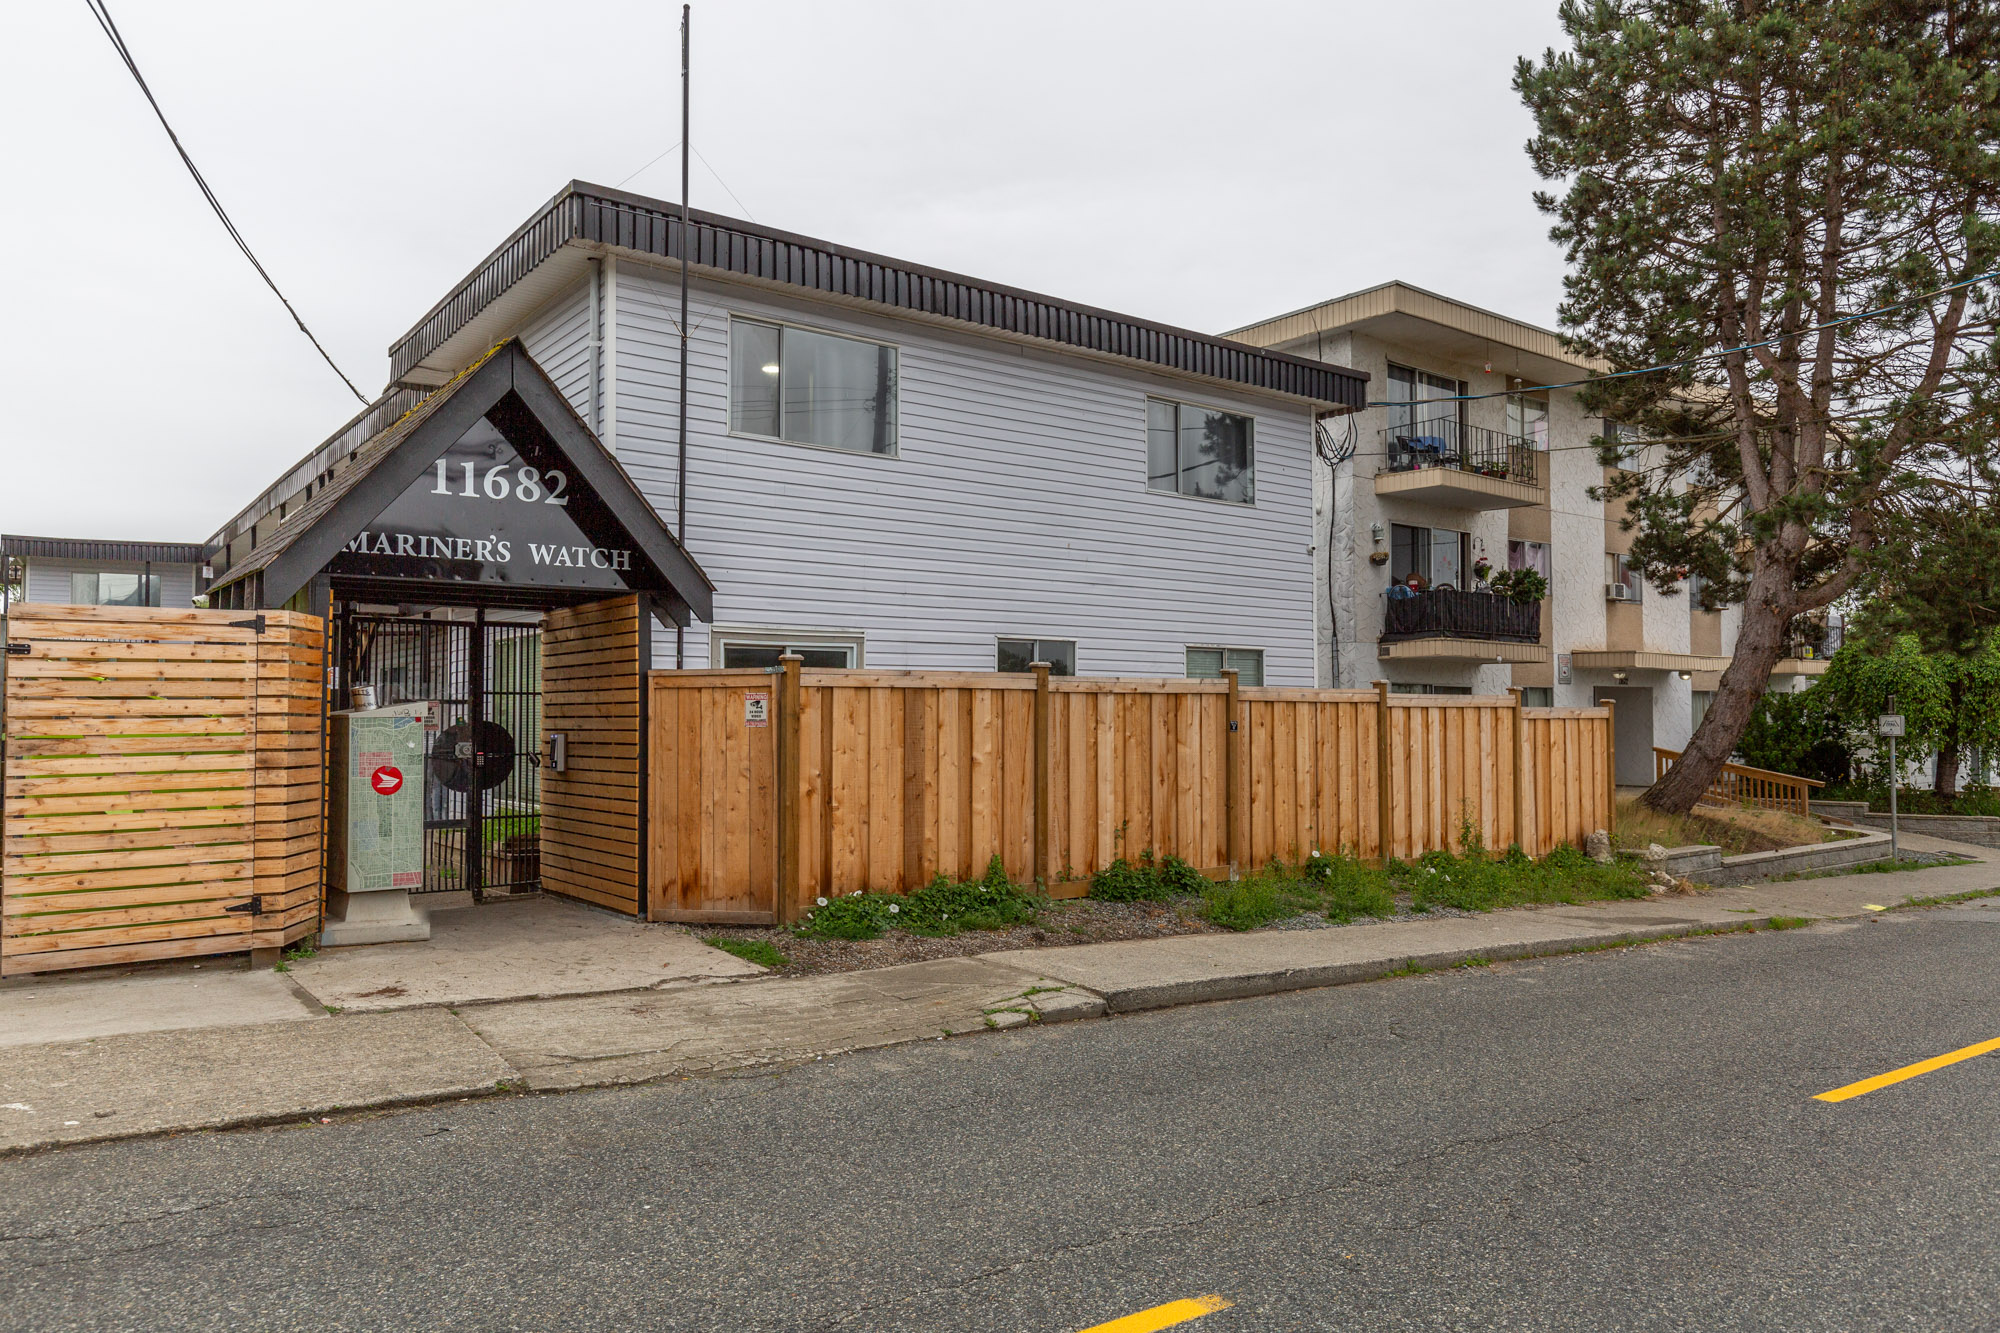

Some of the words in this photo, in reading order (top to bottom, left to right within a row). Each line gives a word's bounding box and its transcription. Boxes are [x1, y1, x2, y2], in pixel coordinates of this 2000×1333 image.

[430, 458, 569, 506] 11682
[341, 531, 511, 562] MARINER'S
[528, 543, 631, 570] WATCH
